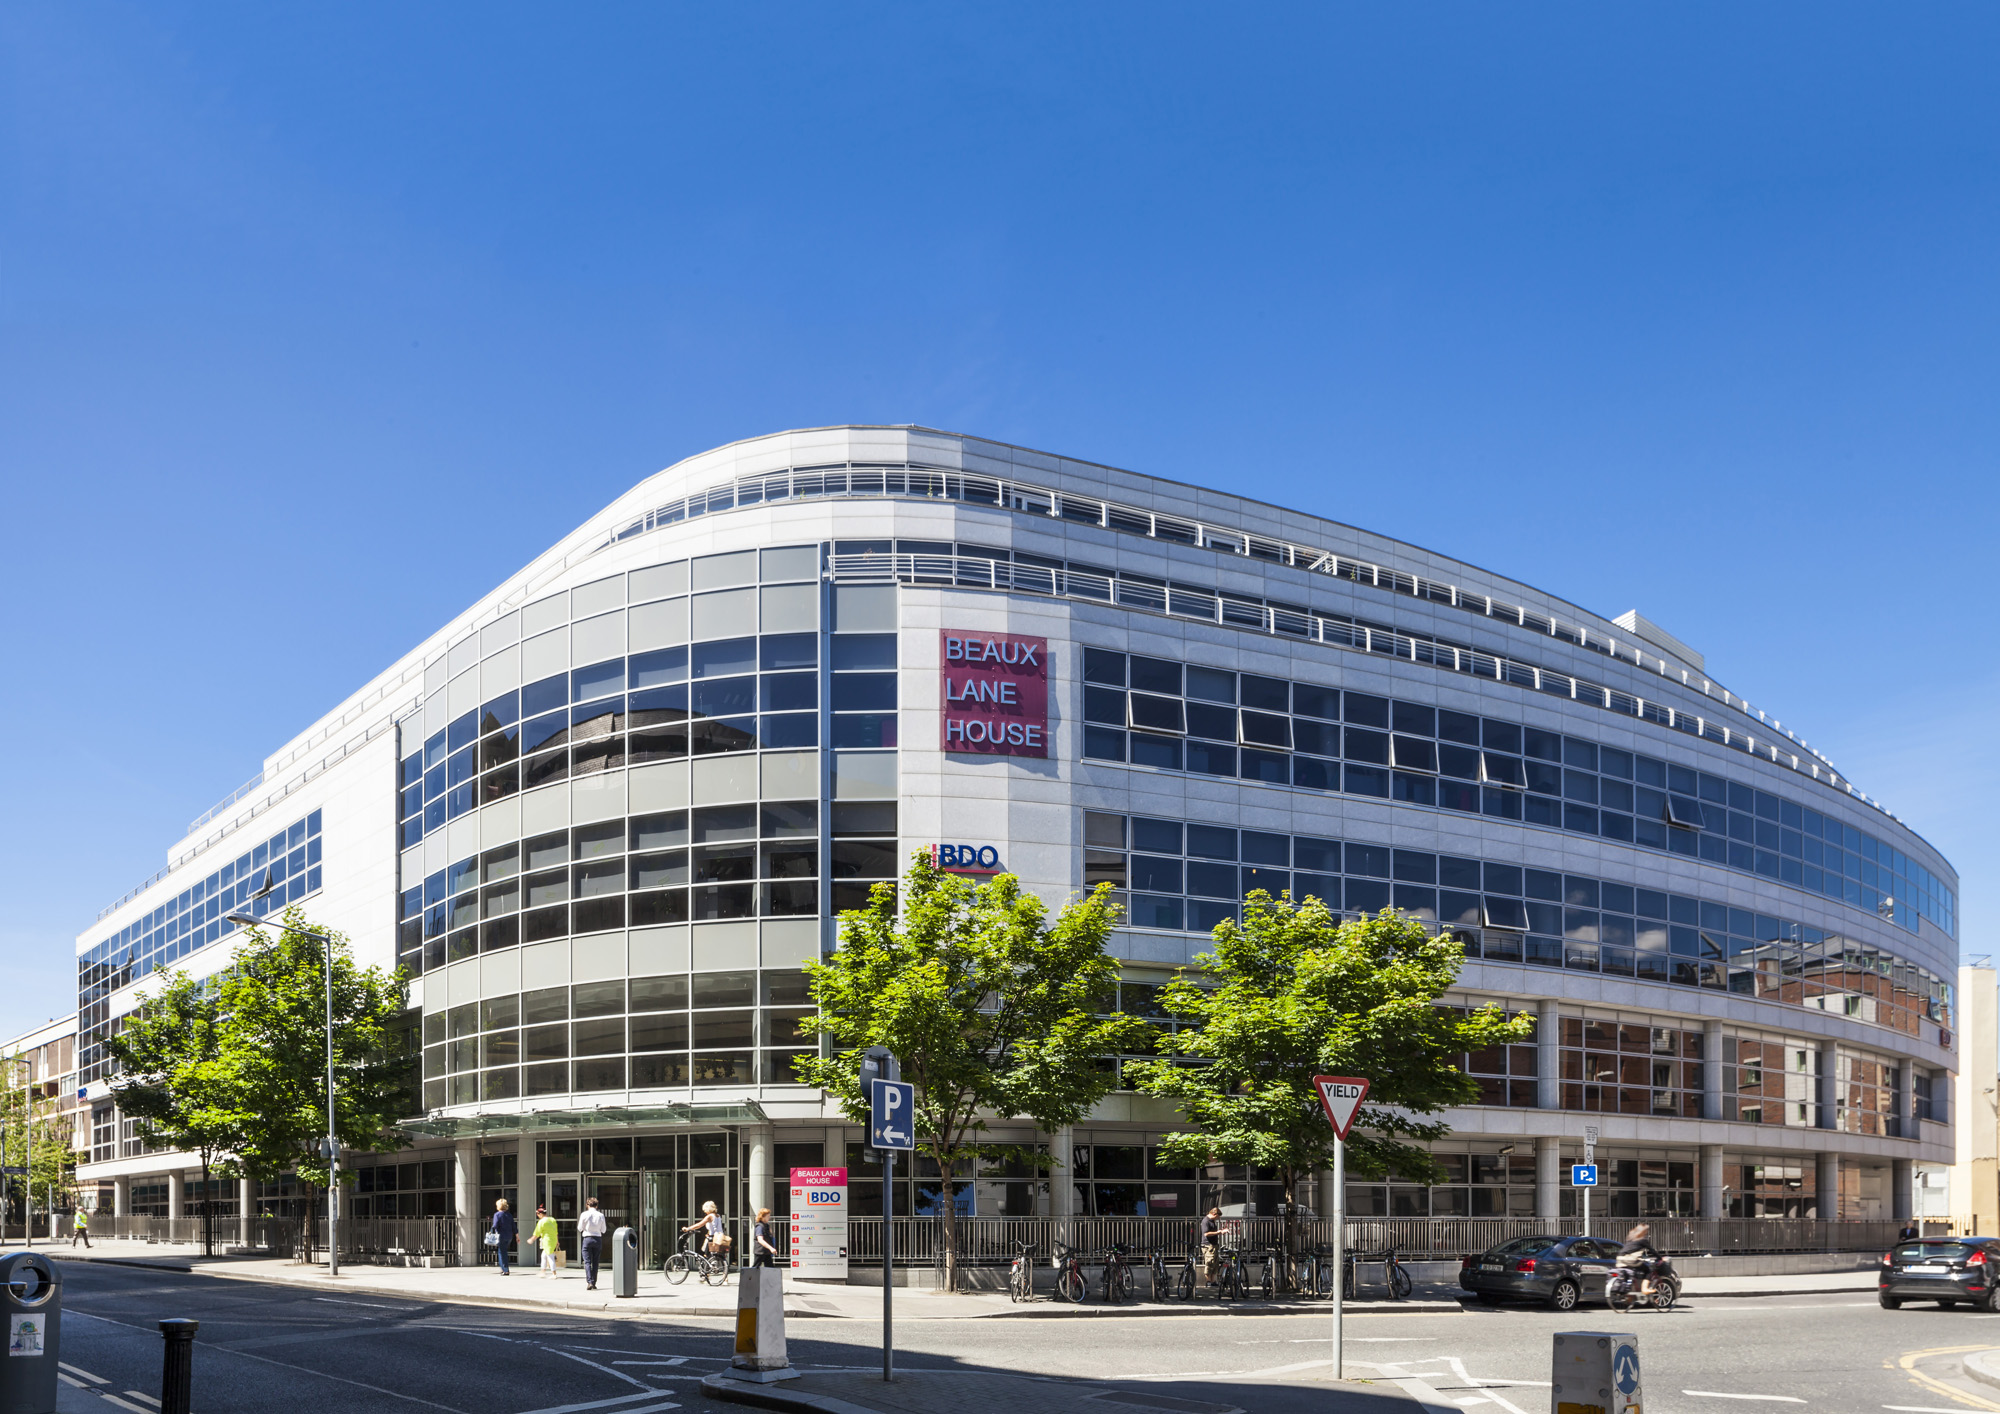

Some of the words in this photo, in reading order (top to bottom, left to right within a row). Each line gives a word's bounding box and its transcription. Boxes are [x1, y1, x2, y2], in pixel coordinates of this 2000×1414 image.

[946, 637, 1038, 666] BEAUX
[946, 678, 1017, 705] LANE
[946, 719, 1042, 747] HOUSE
[939, 843, 999, 868] BDO
[885, 1086, 902, 1121] P
[1325, 1084, 1359, 1098] YIELD
[1580, 1170, 1589, 1181] P
[811, 1191, 840, 1202] BDO
